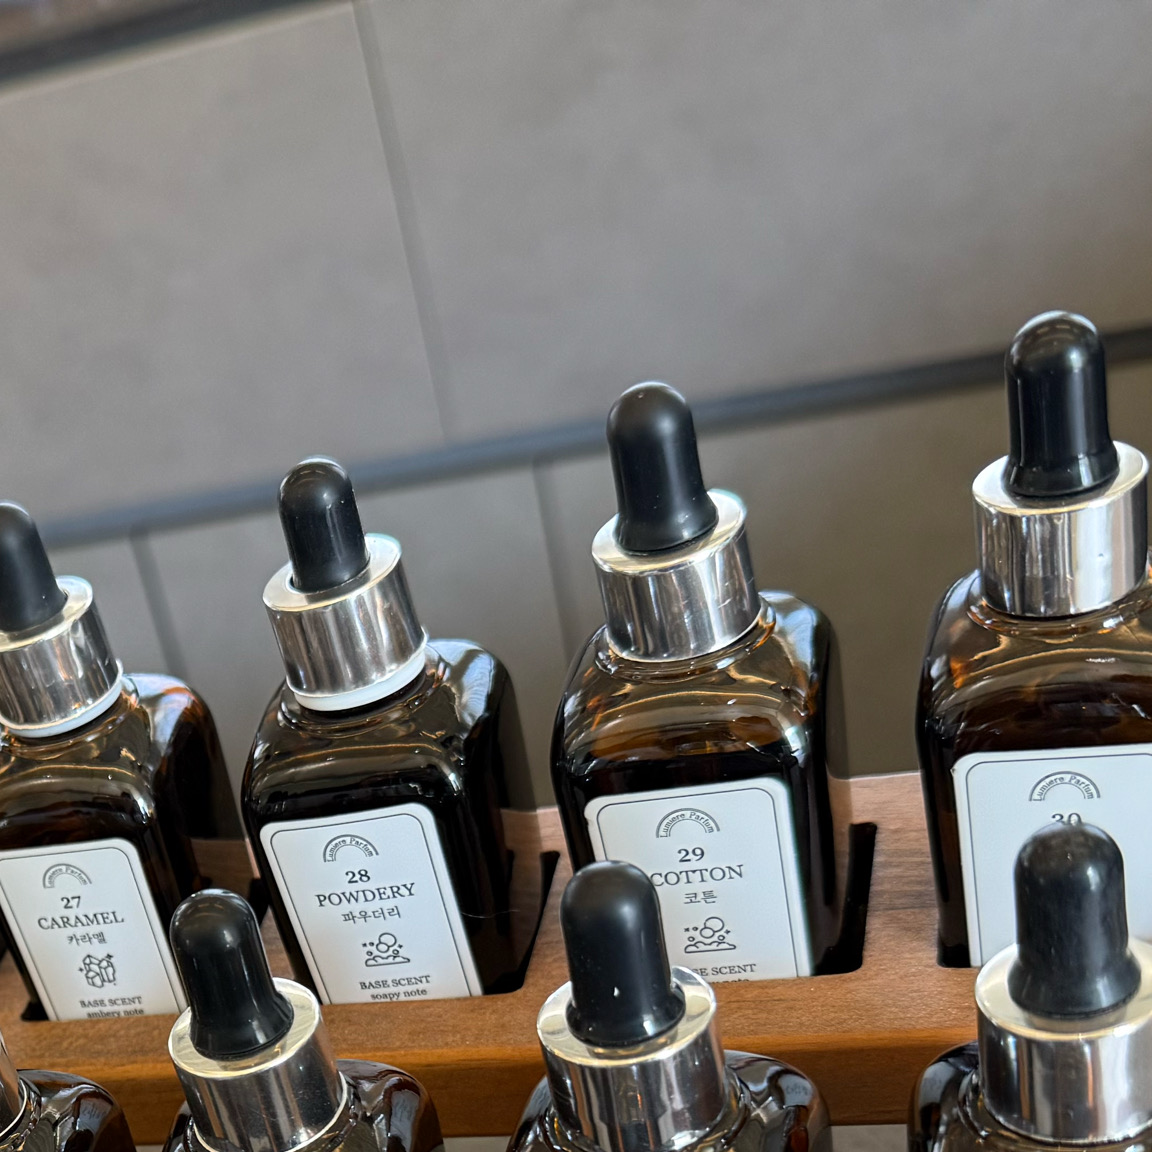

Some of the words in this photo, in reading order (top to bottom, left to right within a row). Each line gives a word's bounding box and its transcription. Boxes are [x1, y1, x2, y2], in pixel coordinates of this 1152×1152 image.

[1034, 776, 1065, 802] Lumiere
[1068, 775, 1094, 800] Parfum
[660, 813, 685, 838] Lumiere
[689, 812, 714, 833] Parfum
[677, 847, 704, 863] 29
[345, 869, 370, 884] 28
[650, 864, 744, 887] COTTON
[61, 896, 81, 909] 27
[315, 883, 415, 907] POWDERY
[37, 911, 124, 930] CARAMEL
[342, 906, 401, 924] 파우더리
[711, 964, 756, 975] SCENT
[360, 980, 390, 990] BASE
[392, 975, 431, 986] SCENT
[80, 1000, 107, 1008] BASE
[110, 996, 142, 1006] SCENT
[371, 991, 400, 1001] soapy
[403, 988, 427, 997] note
[87, 1009, 120, 1018] ambery
[123, 1008, 144, 1016] note
